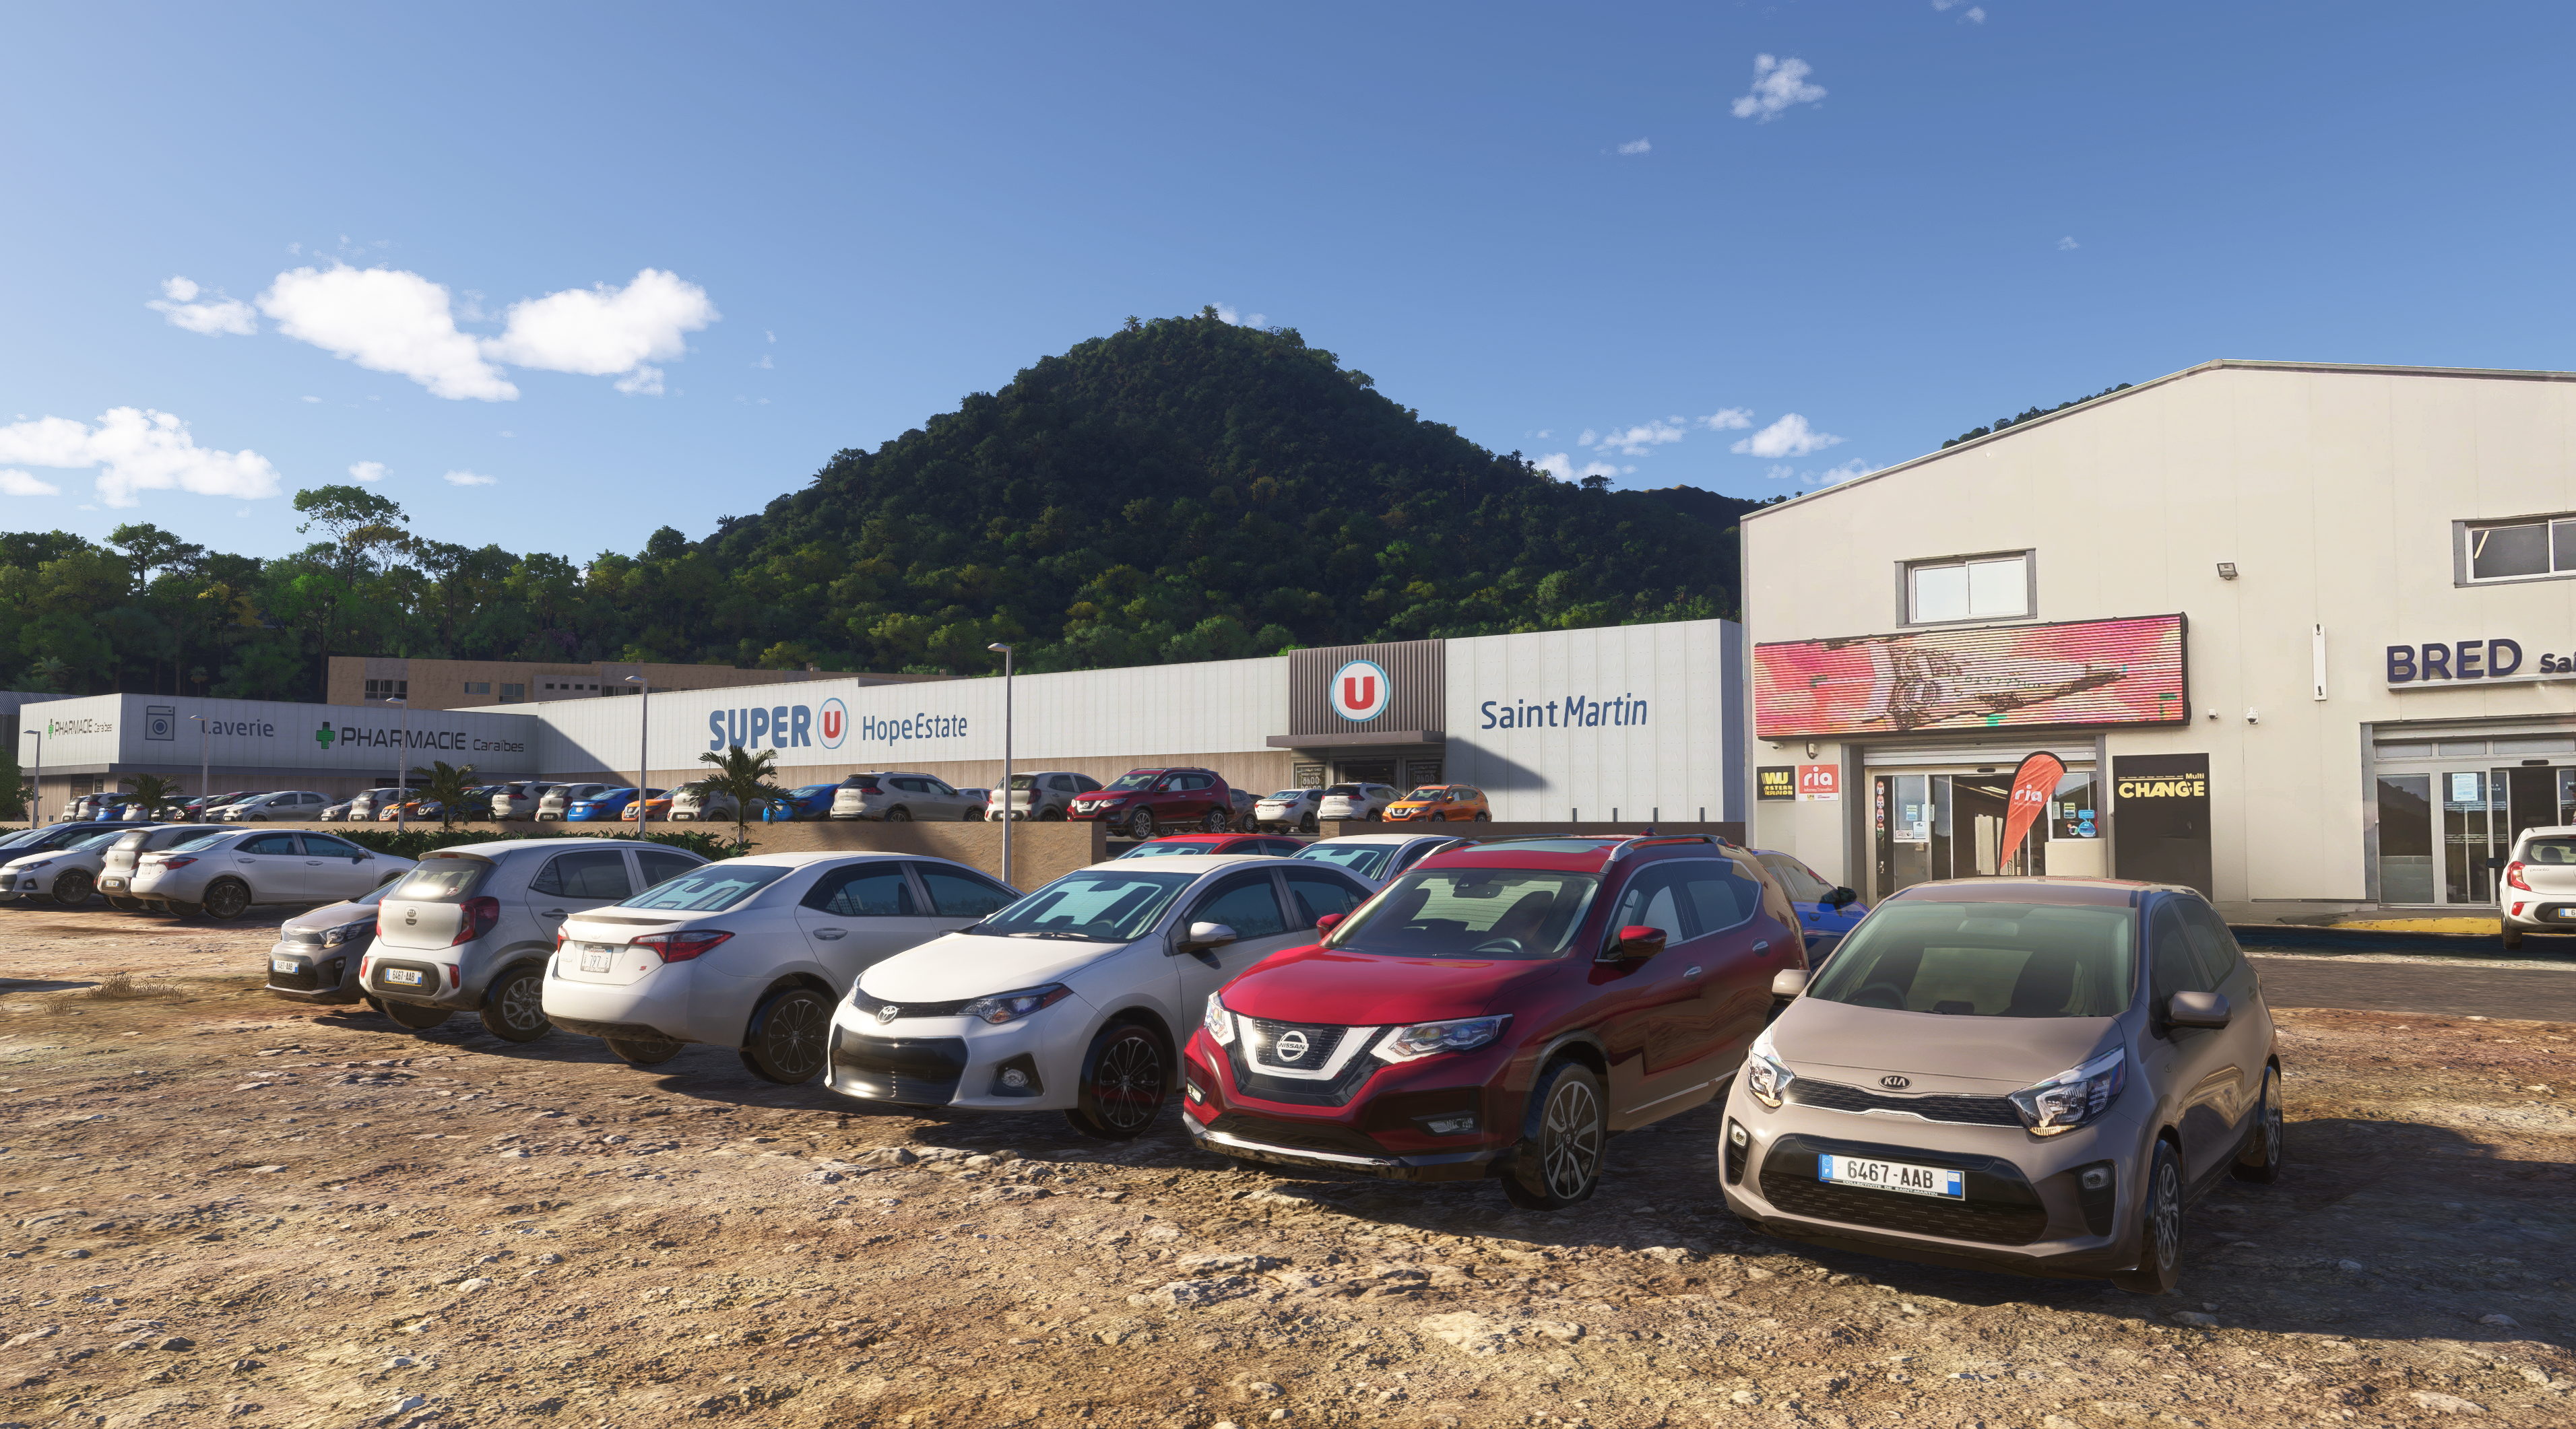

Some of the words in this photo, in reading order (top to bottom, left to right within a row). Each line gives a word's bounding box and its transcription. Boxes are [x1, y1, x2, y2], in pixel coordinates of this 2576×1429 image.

[2387, 638, 2523, 682] BRED
[1344, 676, 1376, 710] U
[55, 719, 92, 736] PHARMACIE
[709, 705, 811, 751] SUPER
[824, 710, 841, 739] U
[341, 727, 466, 750] PHARMACIE
[473, 739, 524, 752] Caraïbes
[1803, 766, 1833, 787] ria
[2014, 784, 2042, 802] ria
[2119, 781, 2205, 798] CHANGE
[1884, 1077, 1906, 1086] KIA
[1847, 1160, 1933, 1189] 6467-AAB
